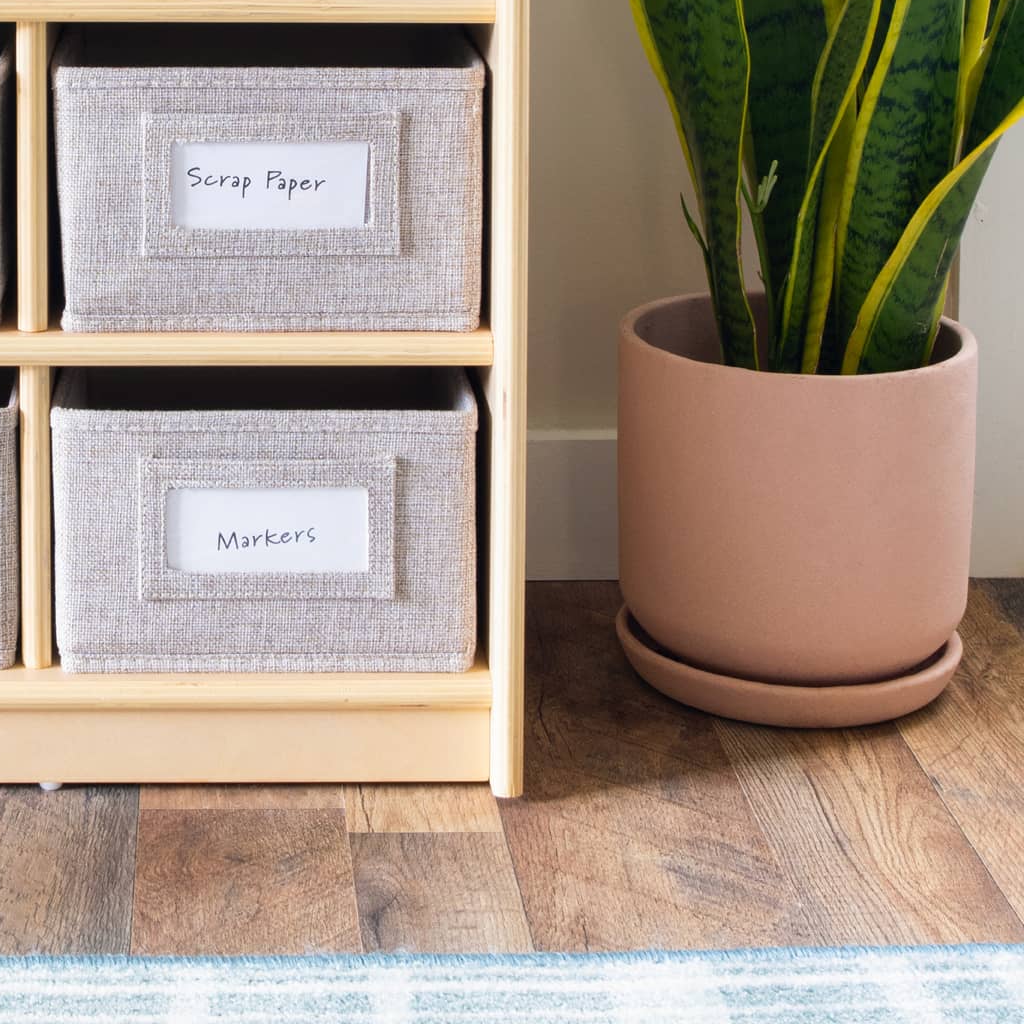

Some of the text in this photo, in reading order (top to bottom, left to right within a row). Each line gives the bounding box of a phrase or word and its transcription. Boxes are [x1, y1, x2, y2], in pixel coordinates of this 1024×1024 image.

[187, 167, 327, 202] Scrap Paper
[217, 526, 318, 550] Markers
